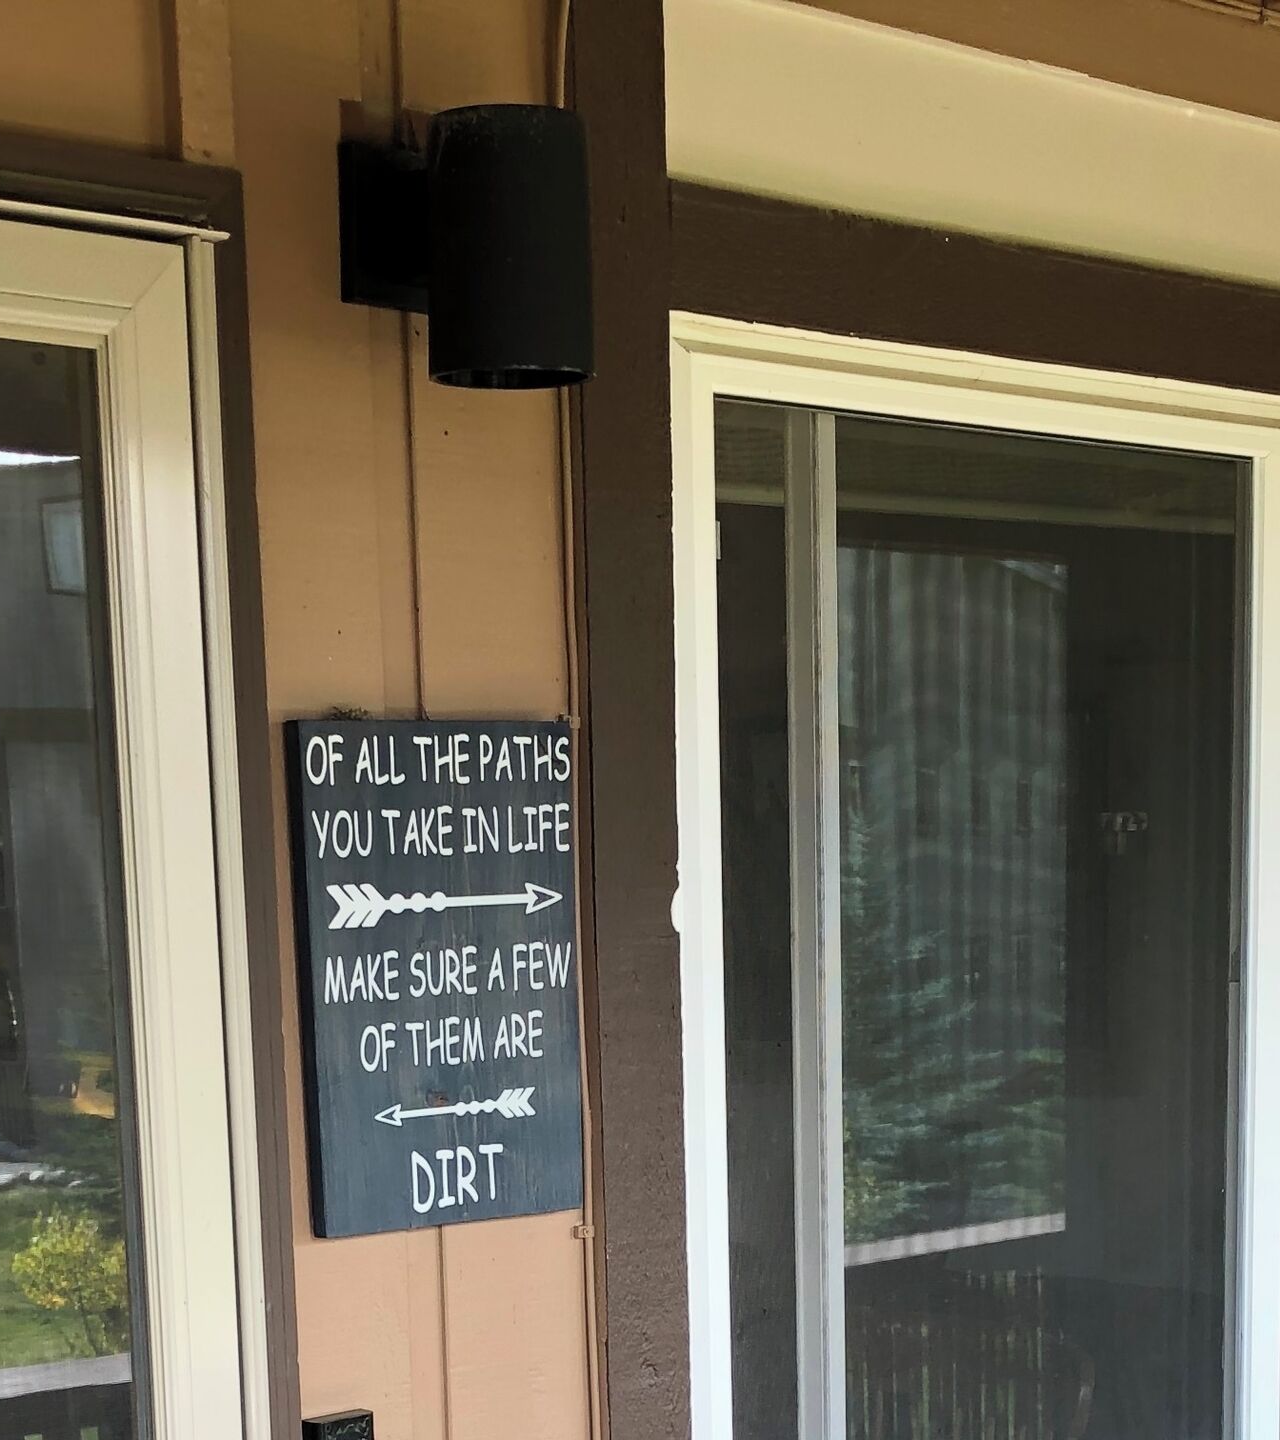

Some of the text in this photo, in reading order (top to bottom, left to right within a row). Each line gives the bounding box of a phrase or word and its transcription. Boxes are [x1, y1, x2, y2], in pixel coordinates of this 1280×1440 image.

[306, 733, 571, 786] OF ALL THE PATHS
[311, 802, 570, 859] YOU TAKE IN LIFE
[324, 941, 572, 1005] MAKE SURE A FEW
[360, 1009, 544, 1073] OF THEM ARE
[410, 1143, 504, 1214] DIRT
